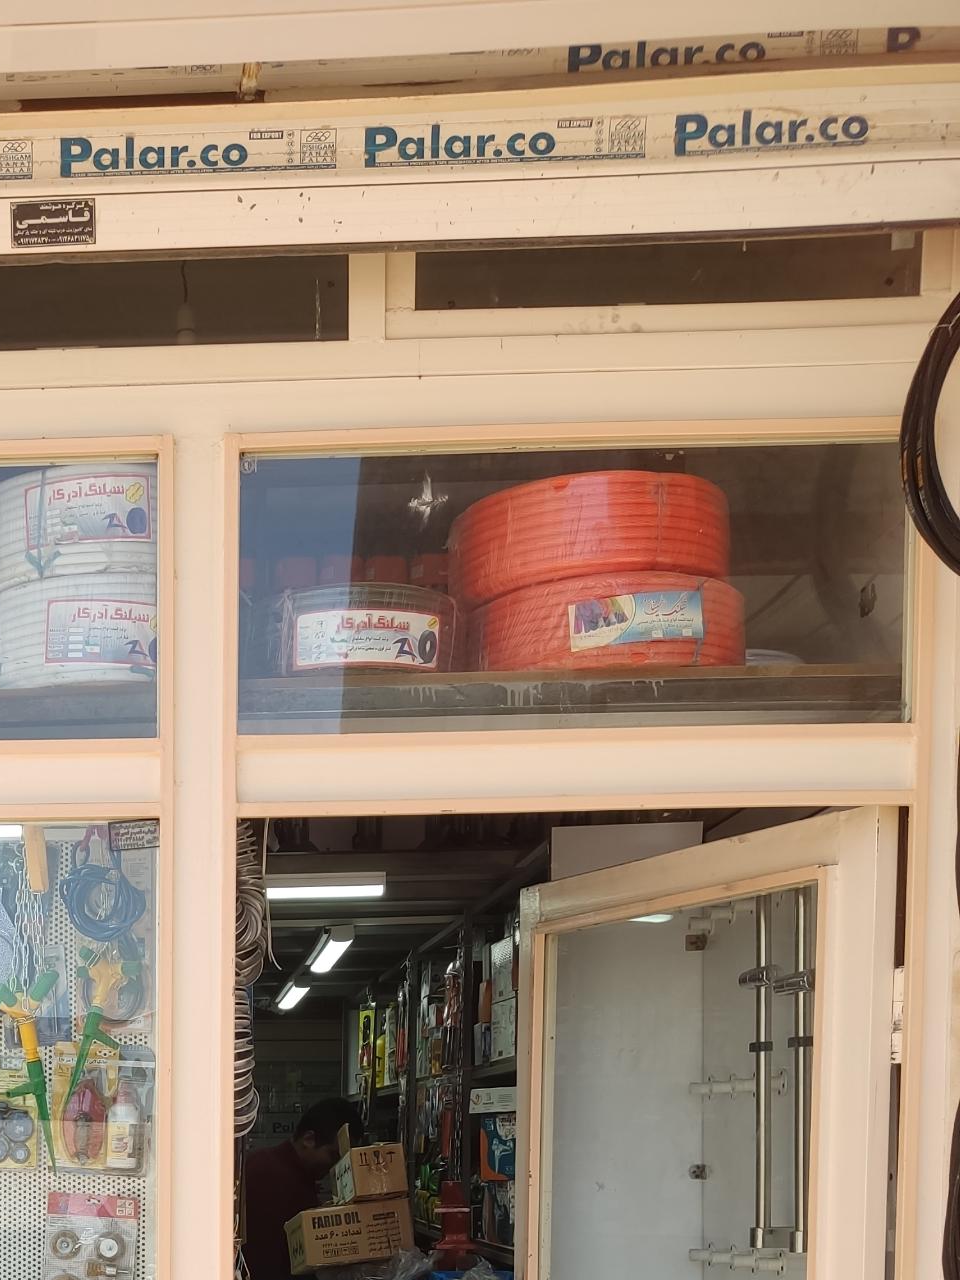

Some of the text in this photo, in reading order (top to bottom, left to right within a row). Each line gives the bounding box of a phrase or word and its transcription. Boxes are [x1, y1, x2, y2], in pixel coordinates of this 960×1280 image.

[364, 124, 556, 168] Palar.co
[674, 110, 869, 157] Palar.co
[59, 135, 248, 178] Palar.co
[16, 208, 91, 229] قاسمی
[312, 1211, 361, 1230] FARID OIL
